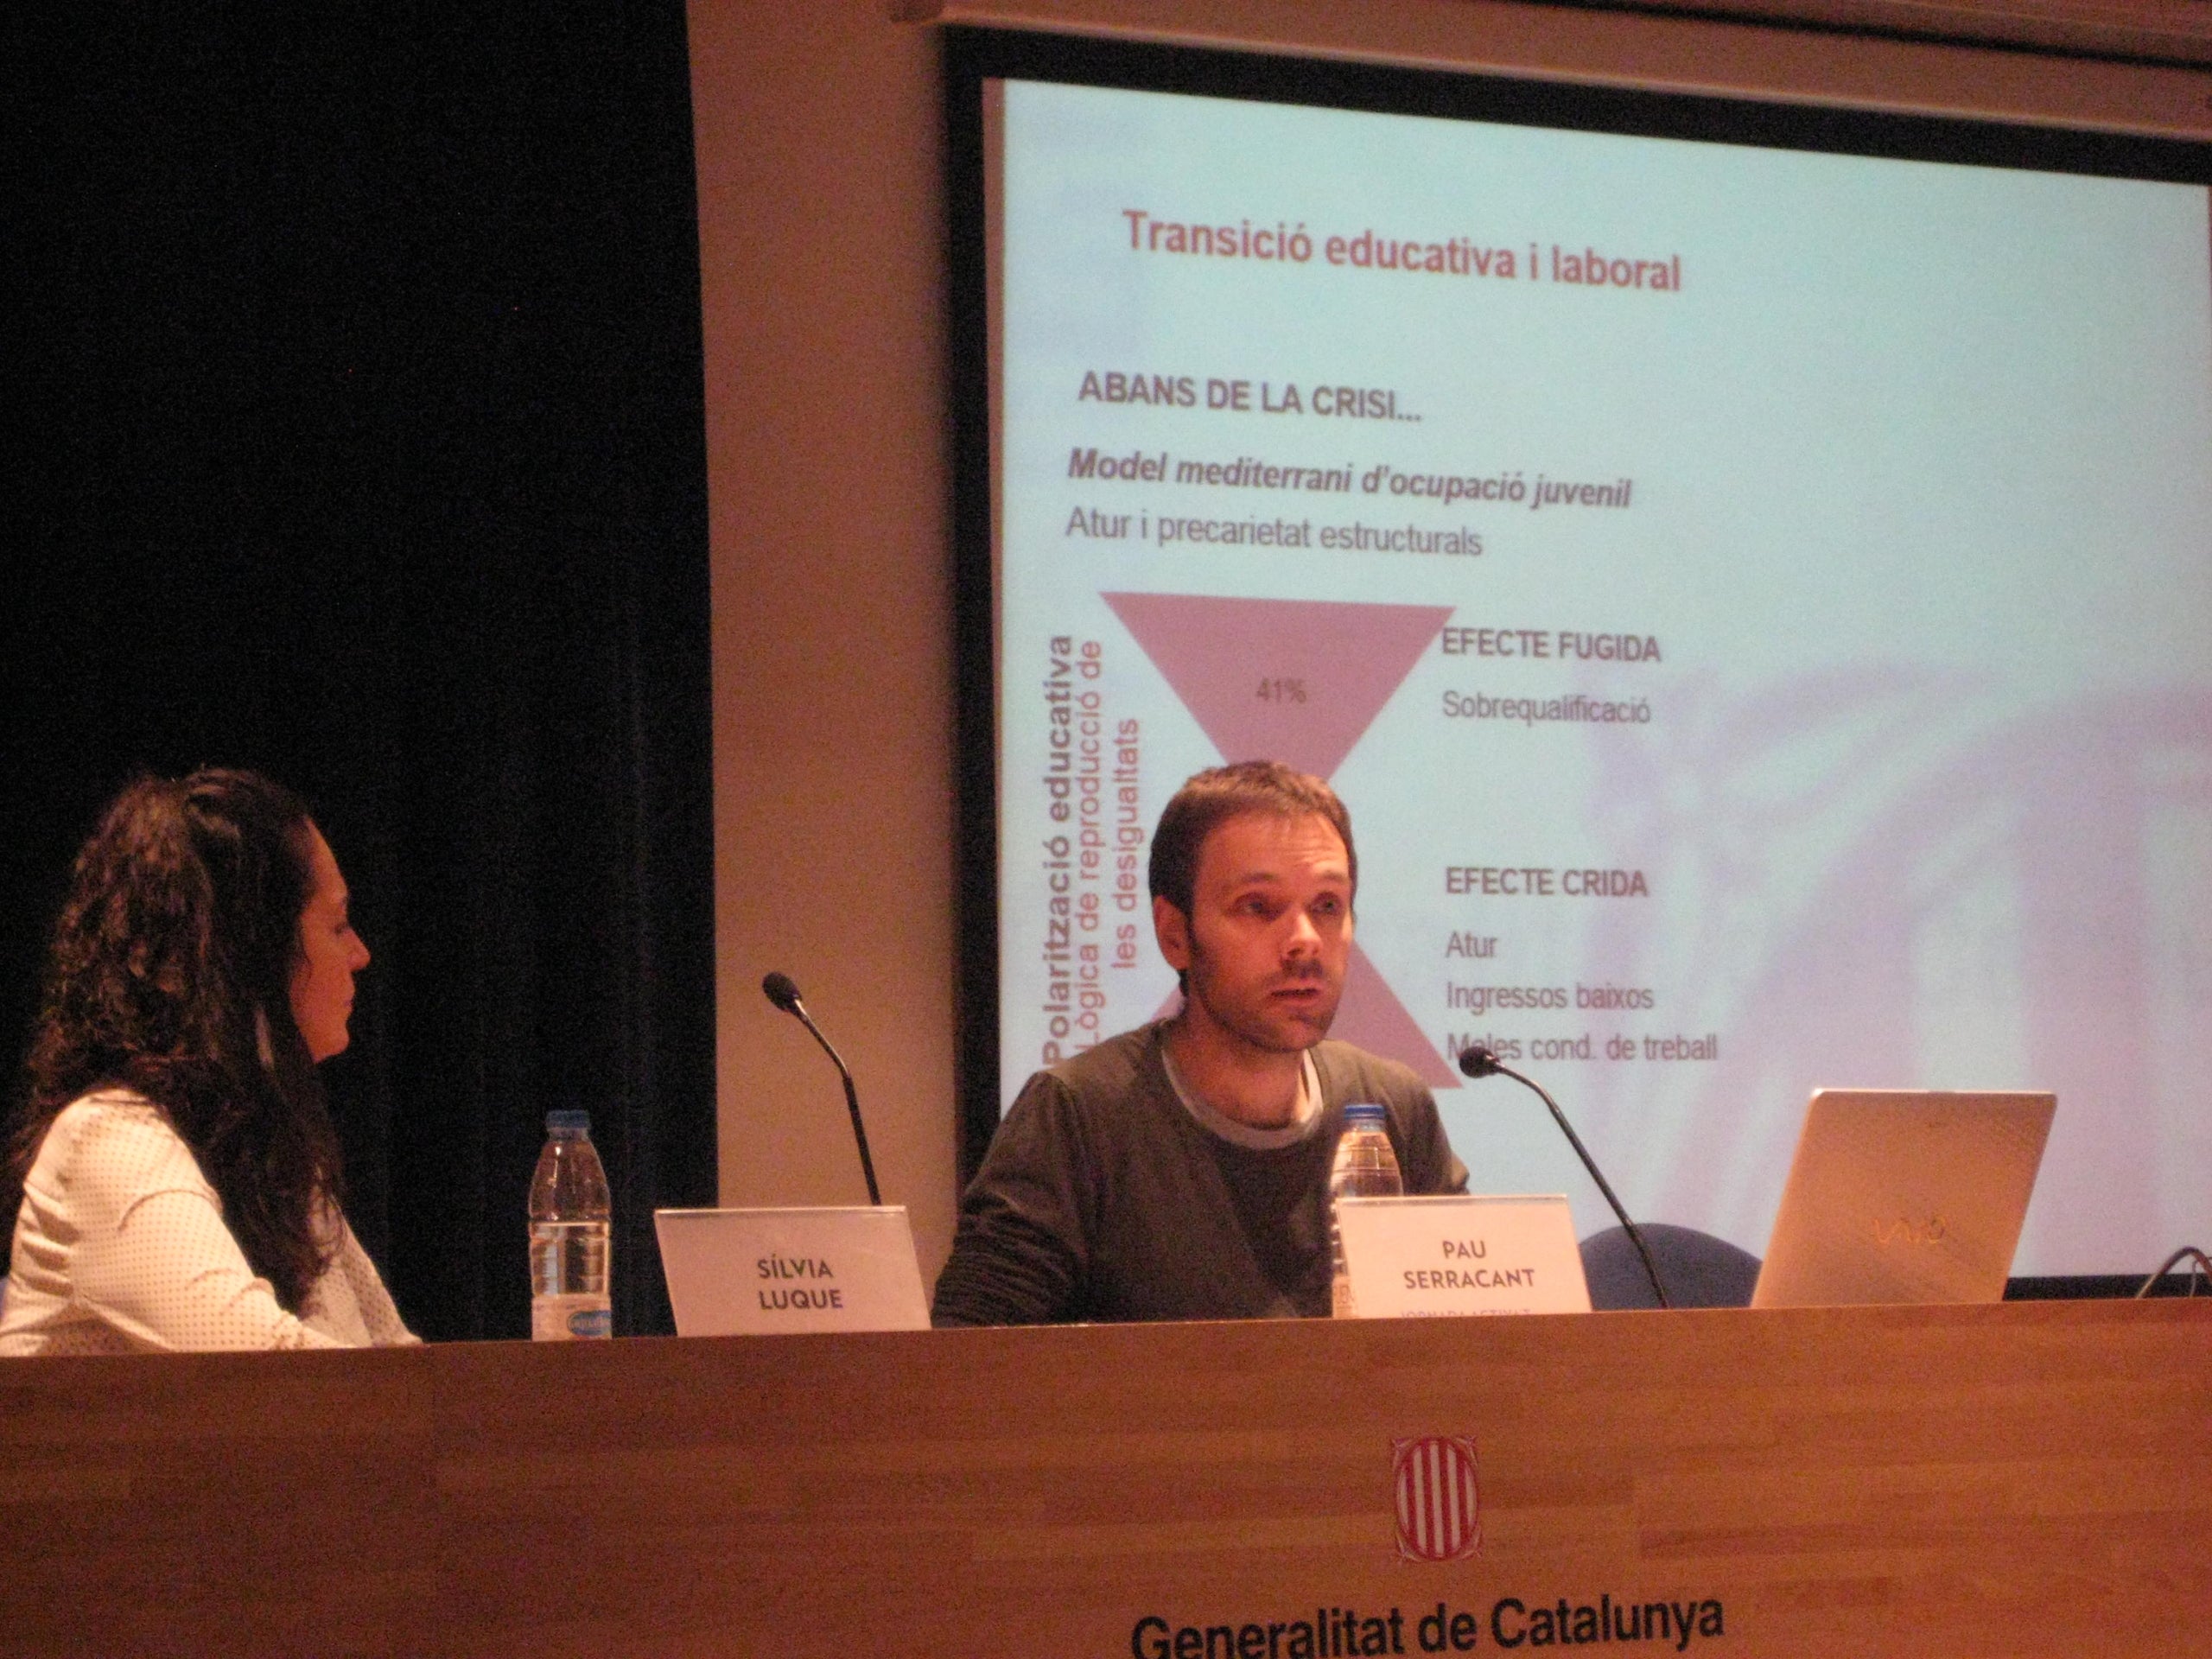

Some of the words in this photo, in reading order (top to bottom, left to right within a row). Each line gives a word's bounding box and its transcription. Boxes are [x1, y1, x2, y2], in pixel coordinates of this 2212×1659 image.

[1123, 208, 1313, 264] Transició
[1325, 229, 1517, 280] educativa
[1529, 243, 1540, 280] i
[1553, 245, 1681, 291] laboral
[1078, 371, 1196, 408] ABANS
[1207, 378, 1252, 412] DE
[1262, 381, 1303, 415] LA
[1312, 385, 1422, 423] CRISI...
[1067, 448, 1168, 483] Model
[1175, 457, 1354, 493] mediterrani
[1362, 464, 1528, 505] d'ocupació
[1530, 477, 1633, 510] juvenil
[1065, 505, 1132, 538] Atur
[1140, 508, 1148, 539] i
[1157, 515, 1312, 548] precarietat
[1319, 521, 1484, 557] estructurals
[1076, 640, 1102, 679] de
[1442, 626, 1550, 659] EFECTE
[1558, 632, 1662, 663] FUGIDA
[1255, 677, 1307, 704] 41%
[1442, 690, 1651, 728] Sobrequalificació
[1042, 635, 1071, 822] educativa
[1075, 691, 1106, 880] reproducció
[1111, 718, 1146, 912] desigualtats
[1446, 866, 1554, 895] EFECTE
[1562, 868, 1649, 898] CRIDA
[1075, 893, 1100, 931] de
[1042, 836, 1071, 1065] Polarització
[1111, 924, 1137, 969] les
[1445, 930, 1498, 958] Atur
[1447, 982, 1568, 1016] Ingressos
[1575, 982, 1655, 1010] baixos
[1530, 1033, 1598, 1060] cond.
[1605, 1033, 1637, 1060] de
[1643, 1033, 1718, 1061] treball
[757, 1252, 834, 1280] SÍLVIA
[1441, 1240, 1488, 1259] PAU
[1403, 1268, 1535, 1290] SERRACANT
[758, 1289, 843, 1311] LUQUE
[1130, 1607, 1405, 1659] Generalitat
[1417, 1603, 1478, 1654] de
[1491, 1594, 1726, 1652] Catalunya
